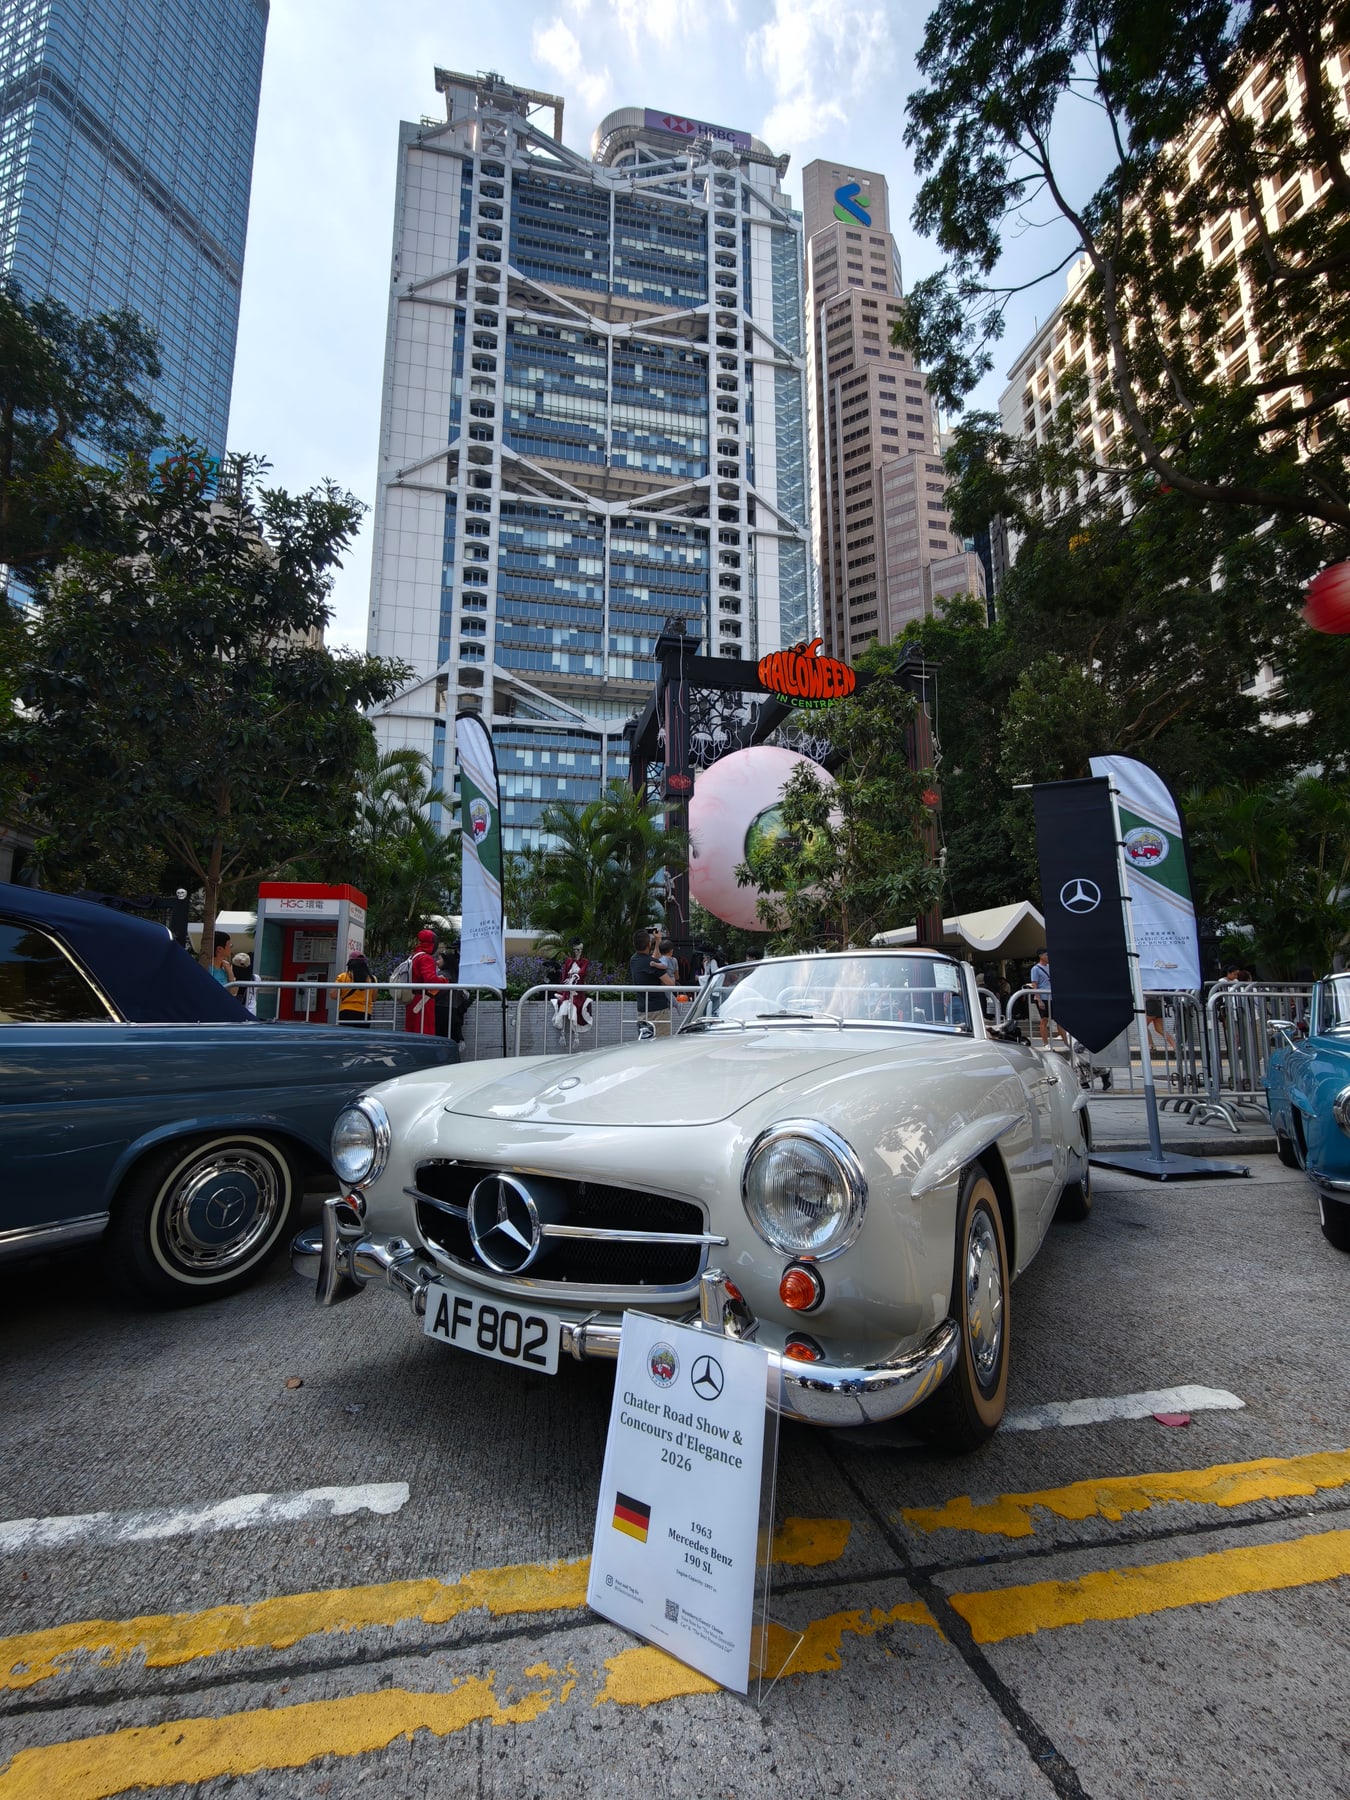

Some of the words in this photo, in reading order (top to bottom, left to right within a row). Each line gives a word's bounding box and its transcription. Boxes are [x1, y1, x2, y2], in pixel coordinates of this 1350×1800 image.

[698, 125, 736, 142] HSBC
[758, 651, 856, 699] HALLOWEEN
[776, 692, 788, 703] IN
[791, 698, 836, 708] CENTRA
[280, 899, 304, 909] HGC
[433, 1293, 473, 1340] AF
[477, 1305, 548, 1367] 802
[623, 1391, 661, 1415] Chater
[663, 1404, 693, 1427] Road
[696, 1416, 730, 1440] Show
[732, 1430, 743, 1446] &
[620, 1411, 673, 1442] Concours
[675, 1432, 743, 1469] d'Elegance
[661, 1448, 692, 1472] 2026
[691, 1521, 712, 1540] 1963
[668, 1527, 709, 1555] Mercedes
[710, 1547, 733, 1568] Benz
[684, 1552, 701, 1568] 190
[702, 1560, 713, 1575] SL
